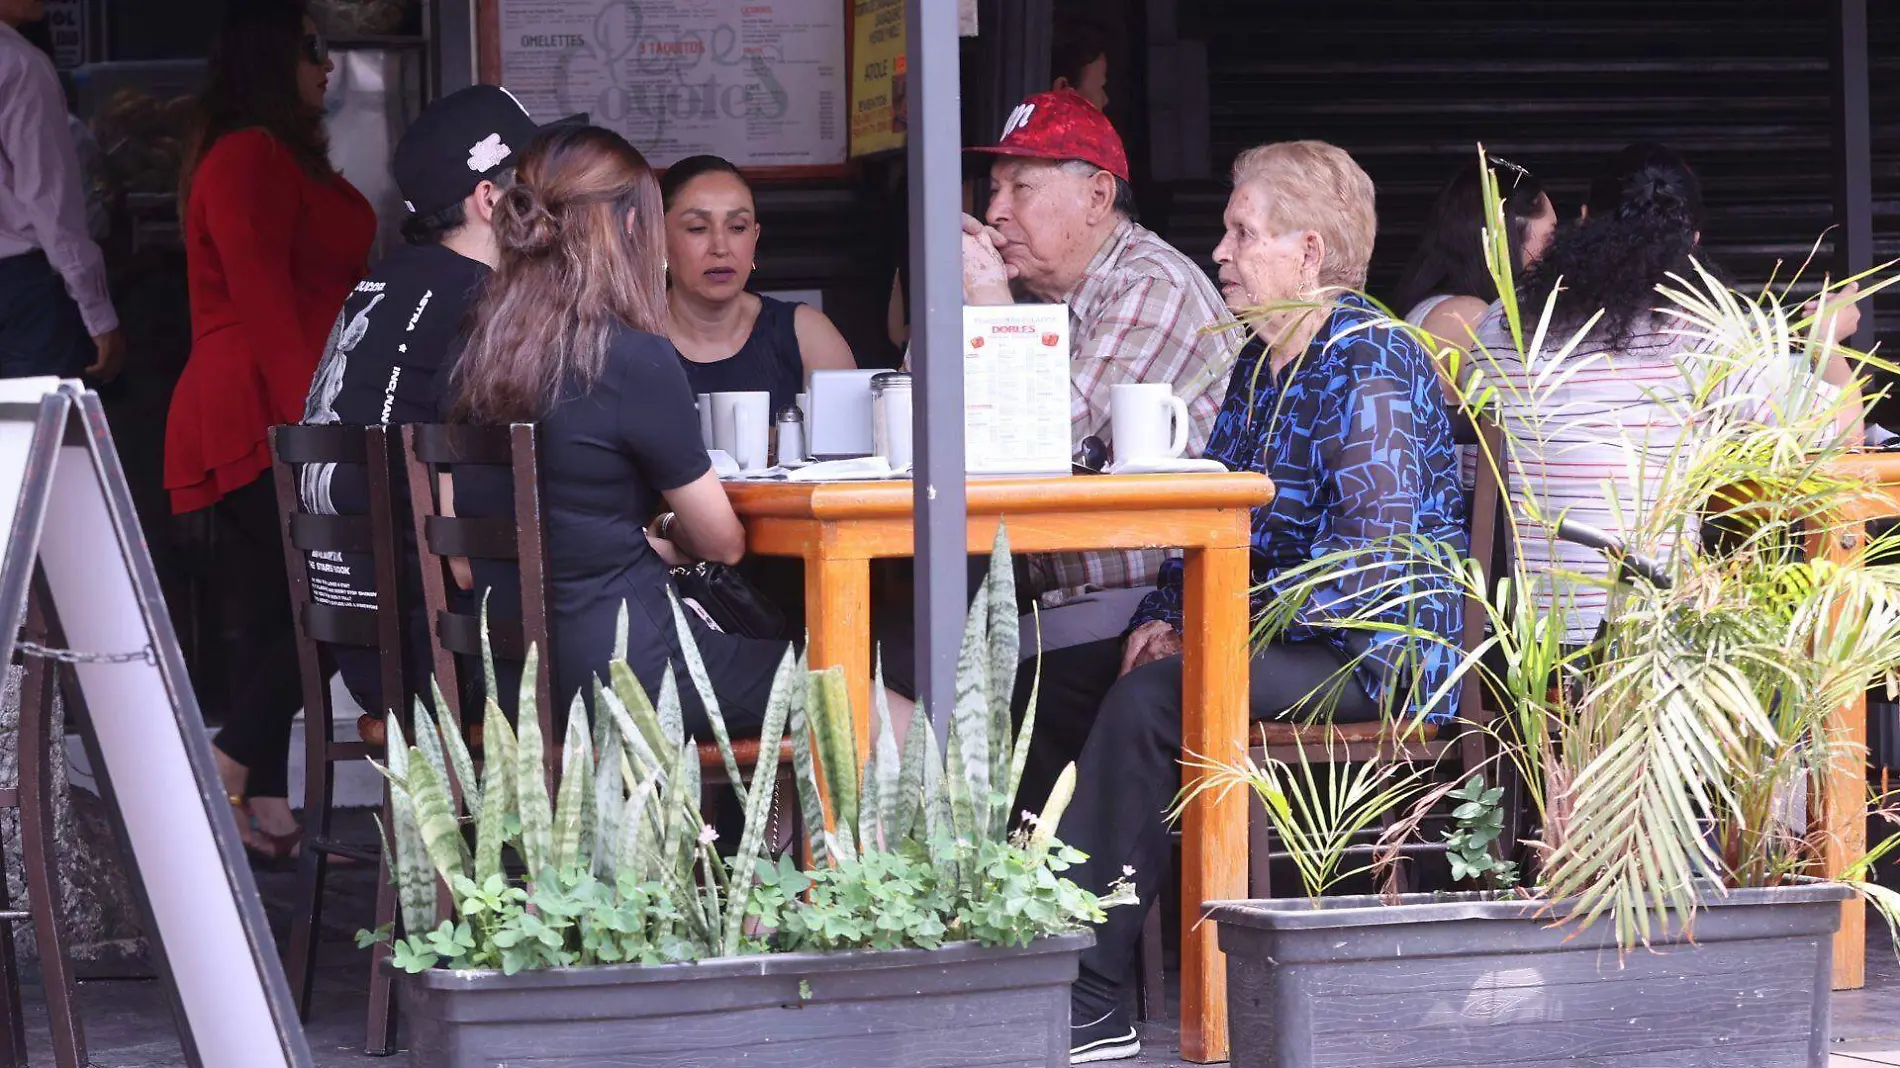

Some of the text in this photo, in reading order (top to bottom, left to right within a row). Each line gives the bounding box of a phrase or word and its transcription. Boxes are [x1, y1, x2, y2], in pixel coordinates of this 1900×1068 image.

[520, 34, 585, 49] OMELETTES
[650, 40, 706, 55] TAQUITOS
[864, 59, 889, 82] ATOLE
[405, 289, 434, 332] ASTRA
[992, 326, 1036, 334] DOBLES
